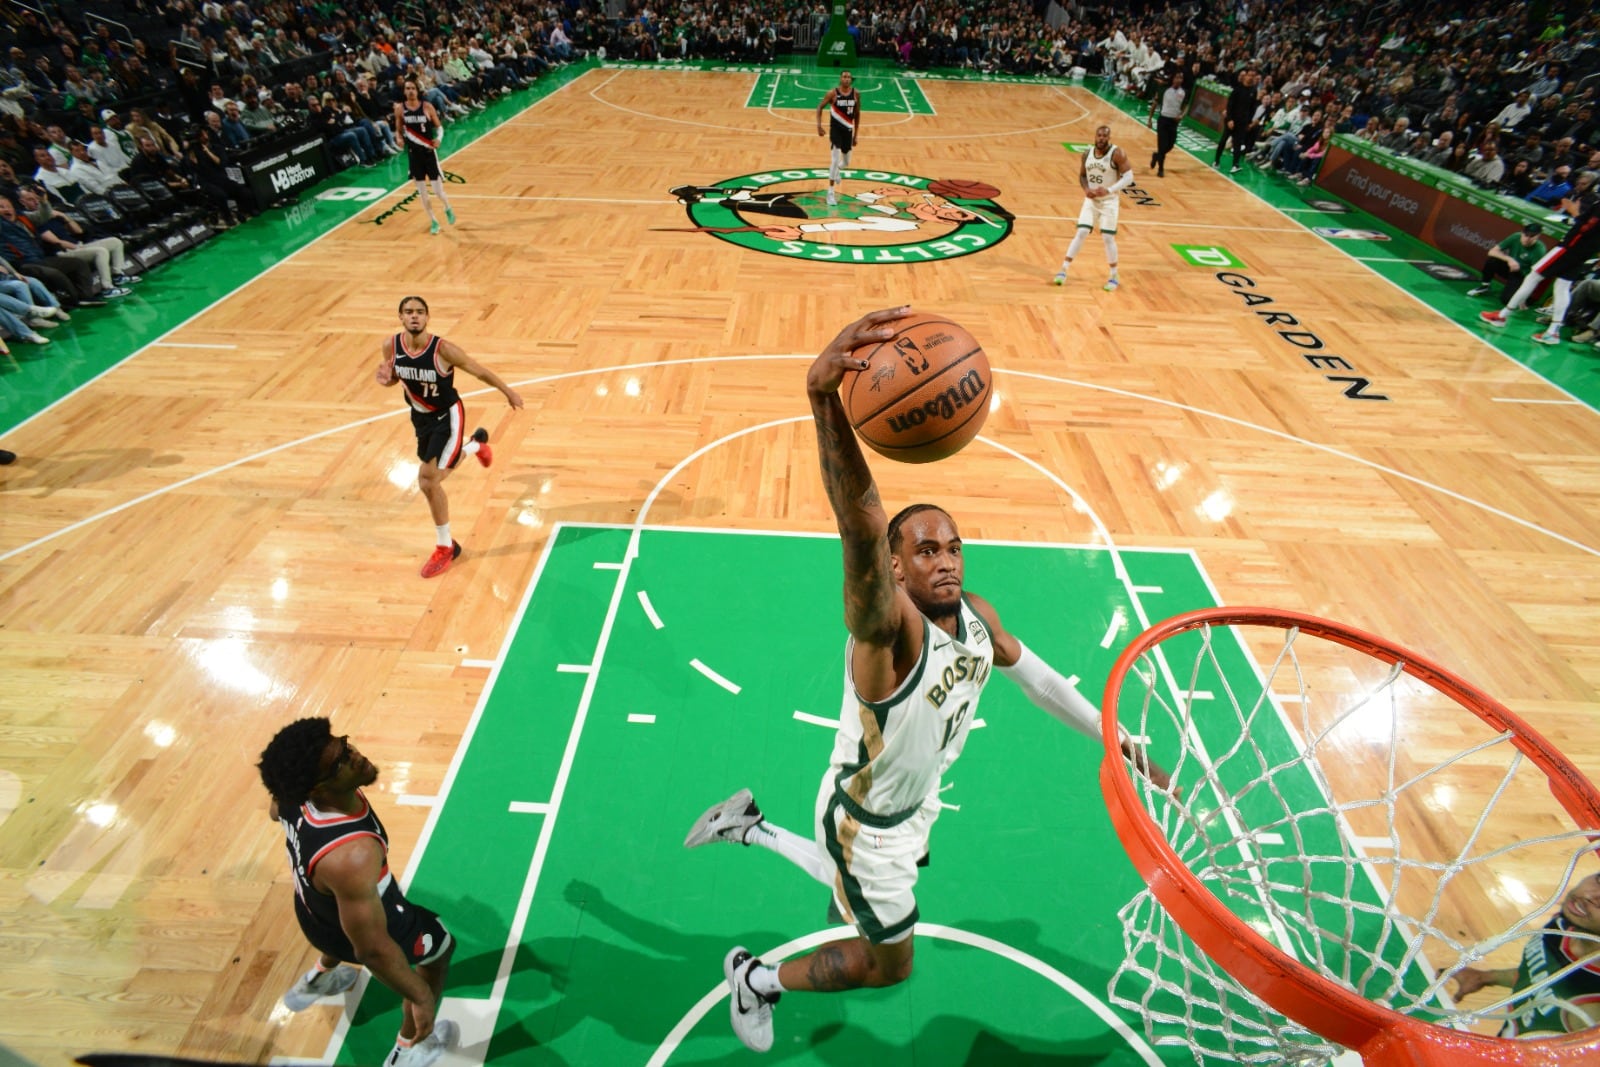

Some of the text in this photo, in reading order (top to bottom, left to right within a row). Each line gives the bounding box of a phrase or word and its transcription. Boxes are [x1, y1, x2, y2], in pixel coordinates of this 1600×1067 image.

[601, 63, 802, 74] BOSTON CELTICS
[285, 162, 303, 176] Meet
[288, 165, 316, 186] BOSTON
[750, 169, 923, 187] BOSTON
[1089, 174, 1104, 184] 26
[269, 168, 291, 194] MB
[1345, 167, 1420, 215] Find your pace
[777, 233, 988, 262] CELTICS
[1185, 247, 1233, 267] TD
[1215, 271, 1391, 402] GARDEN
[394, 364, 437, 383] PORTLAND
[420, 382, 440, 398] 72
[885, 367, 986, 434] Wilson
[937, 700, 970, 752] 12
